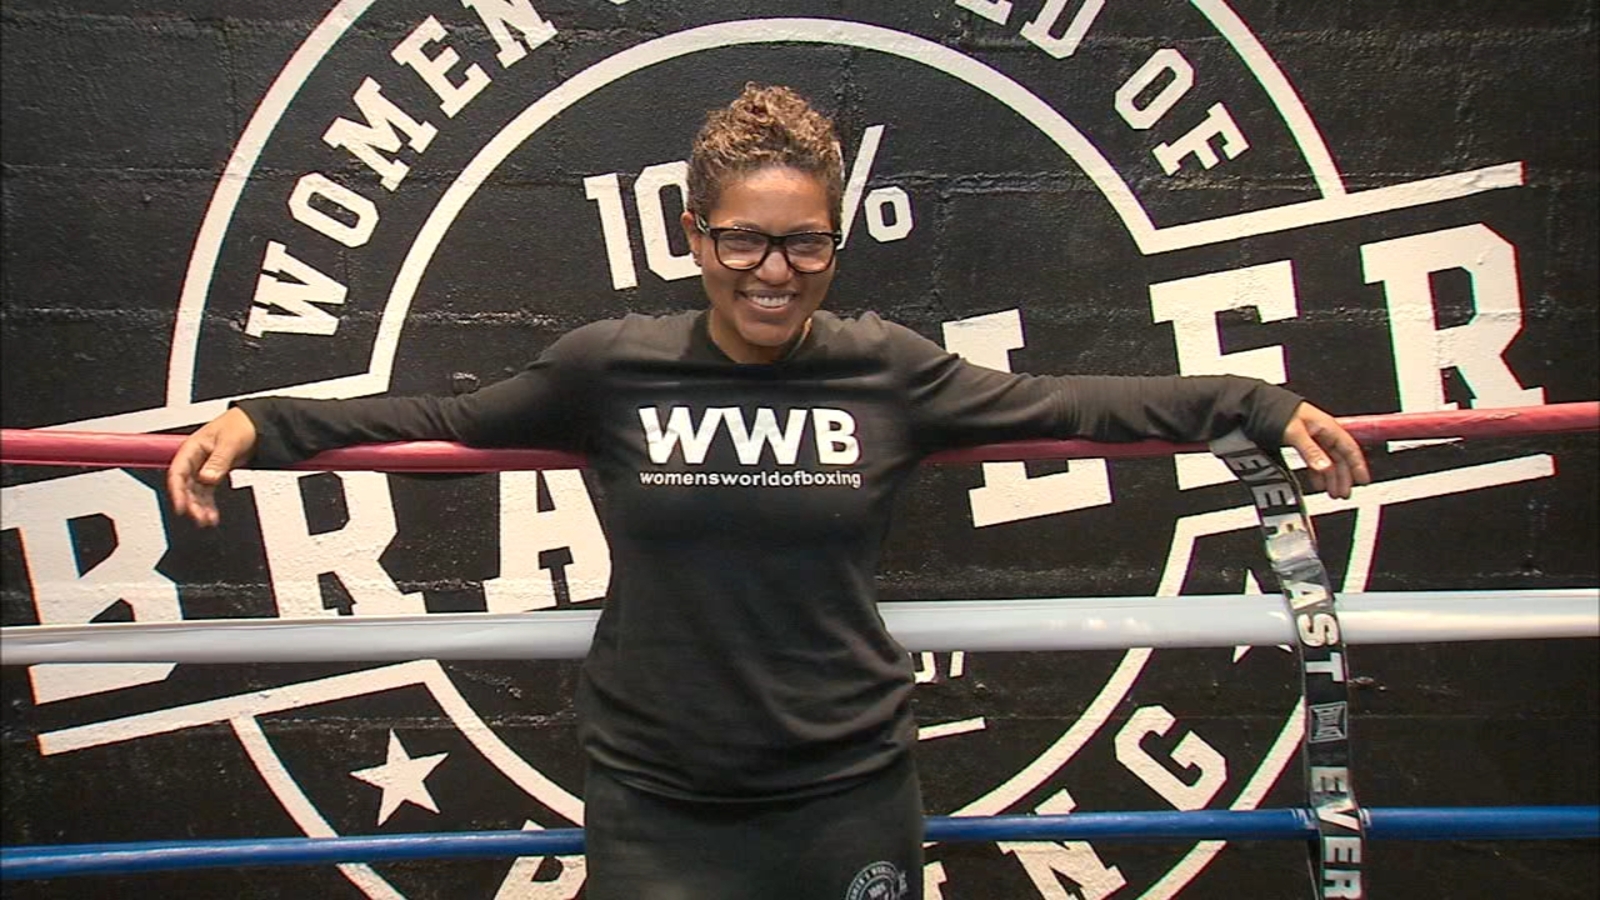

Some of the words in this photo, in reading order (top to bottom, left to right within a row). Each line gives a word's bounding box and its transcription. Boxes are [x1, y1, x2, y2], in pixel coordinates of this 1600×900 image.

[1114, 47, 1249, 176] OF
[638, 406, 861, 466] WWB
[639, 470, 862, 488] womensworldofboxing
[1223, 453, 1345, 682] EVERAST
